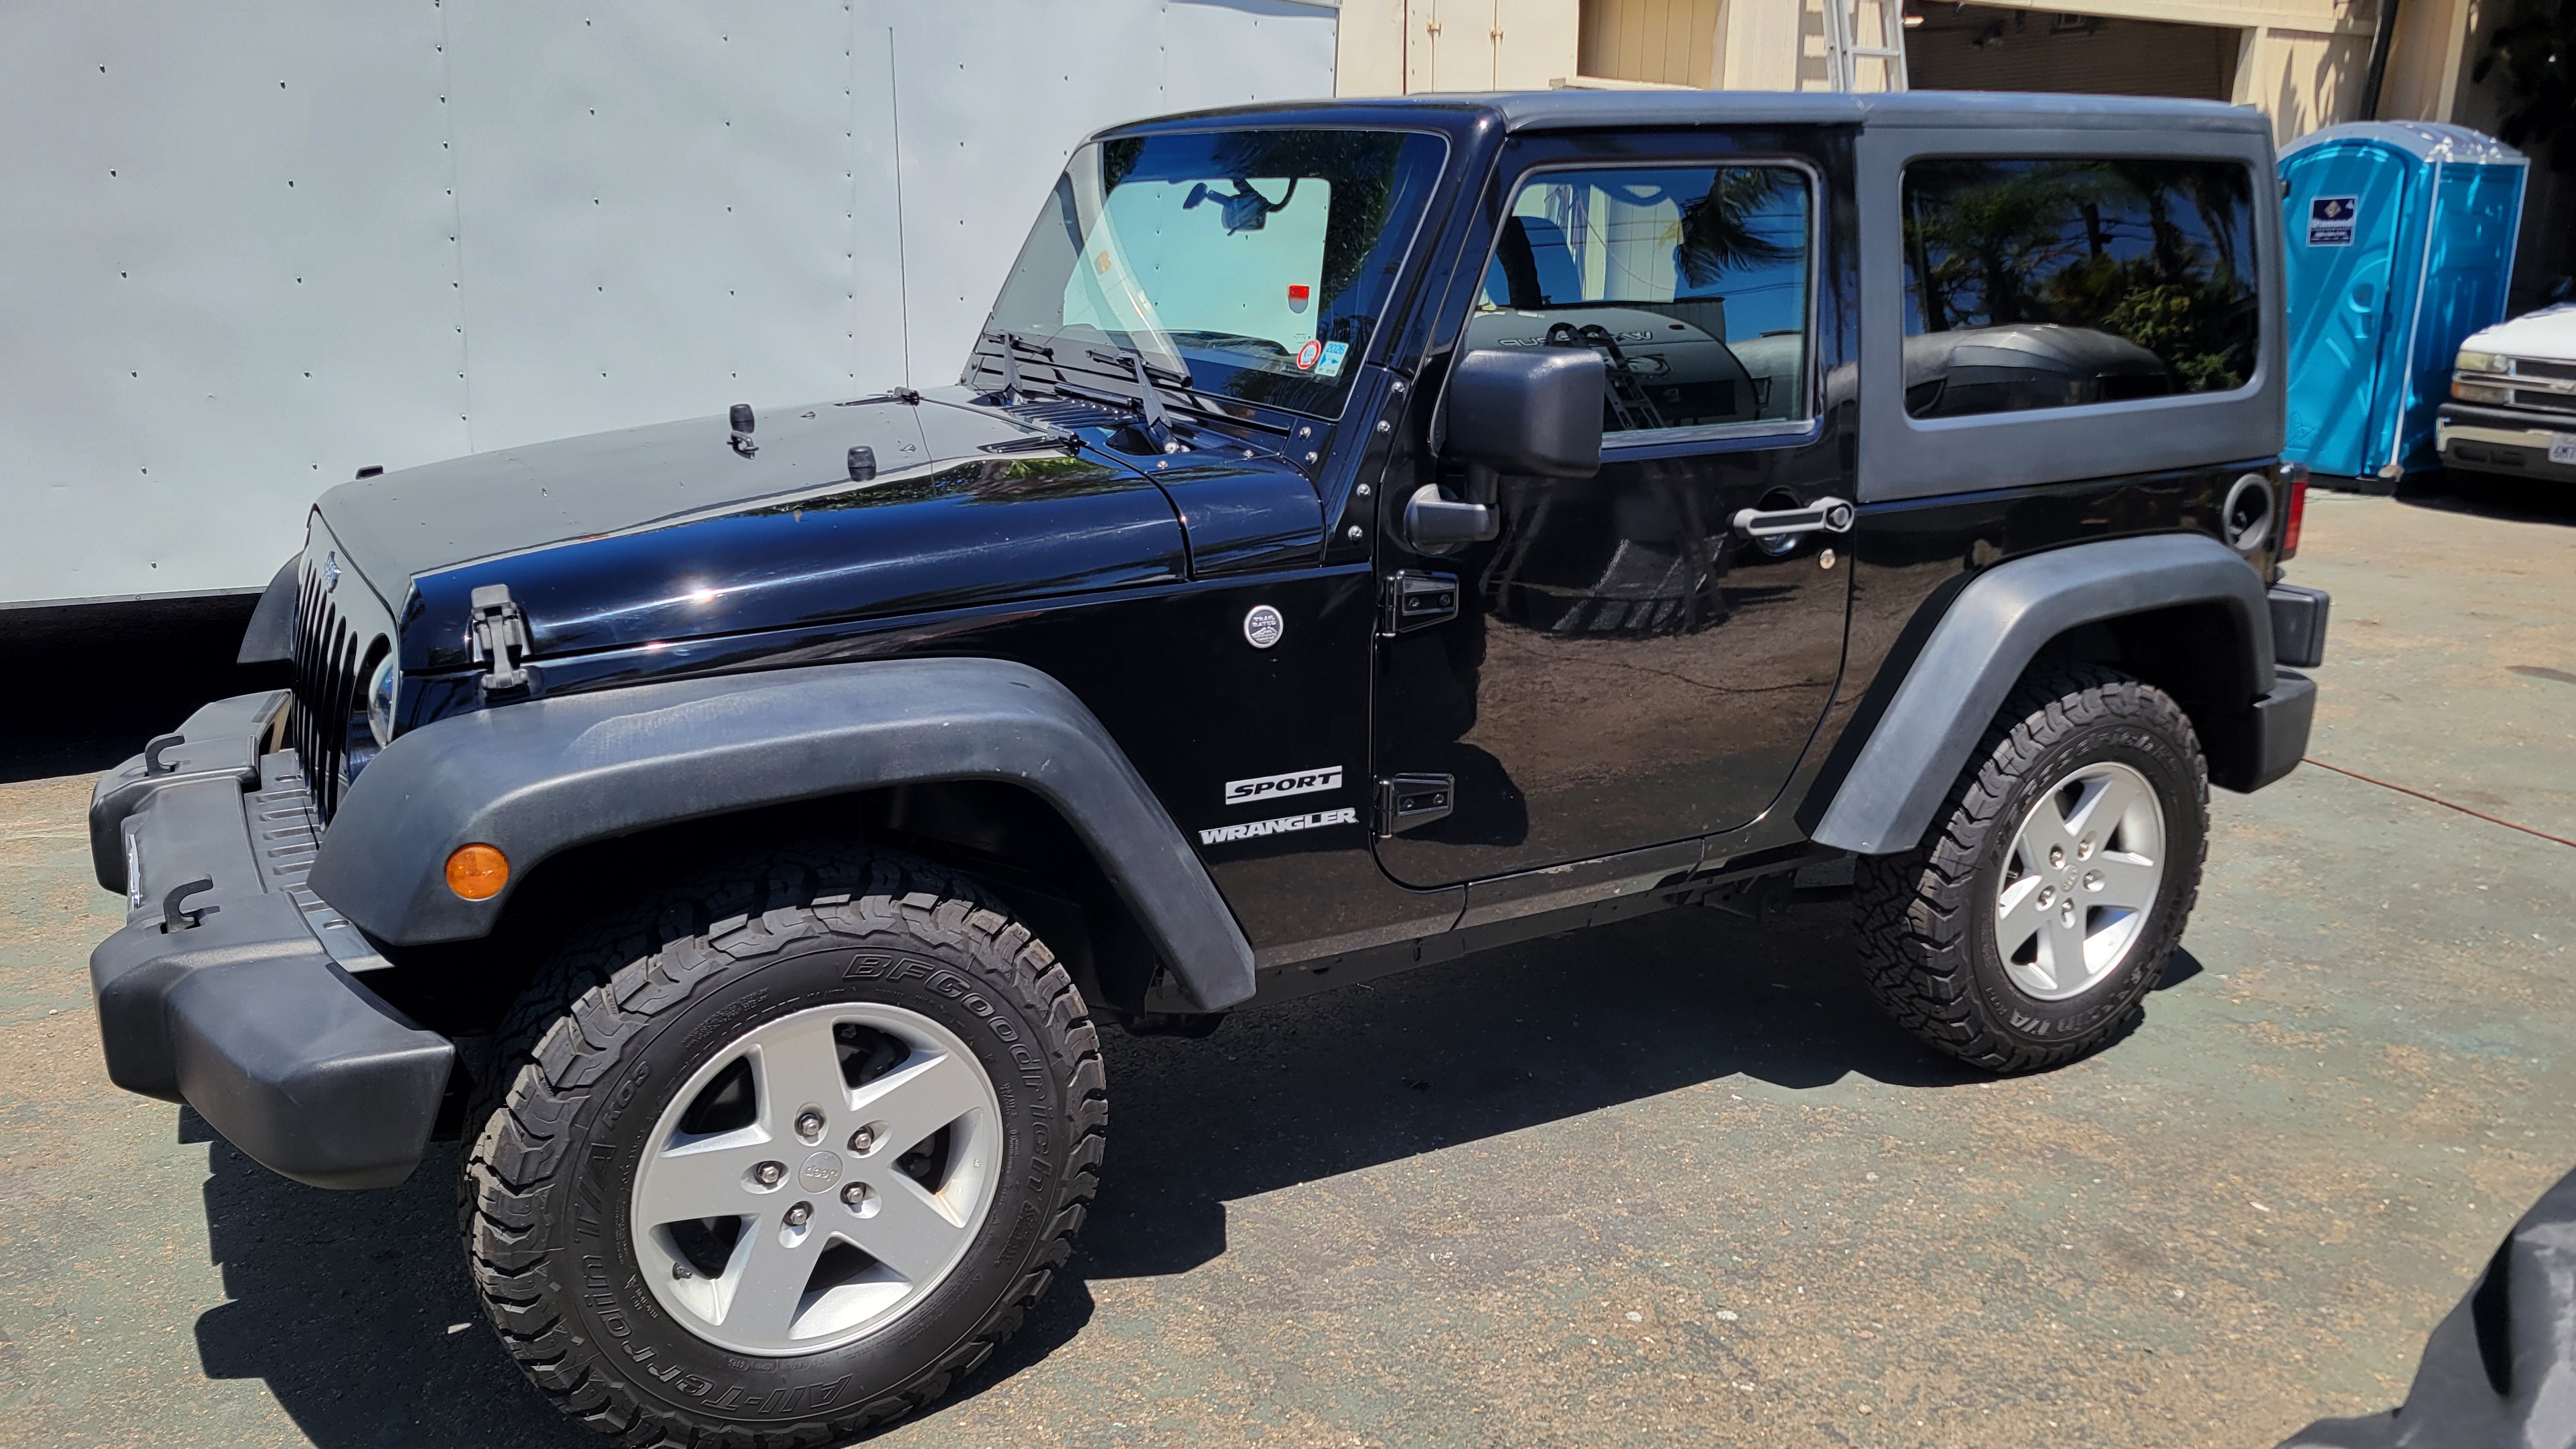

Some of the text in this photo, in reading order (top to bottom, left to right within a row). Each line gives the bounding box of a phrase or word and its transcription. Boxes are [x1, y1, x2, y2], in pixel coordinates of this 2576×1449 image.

[1326, 343, 1346, 355] 2026
[1227, 770, 1342, 800] SPORT
[1199, 807, 1360, 845] WRANGLER
[842, 954, 1054, 1192] BFGoodrich
